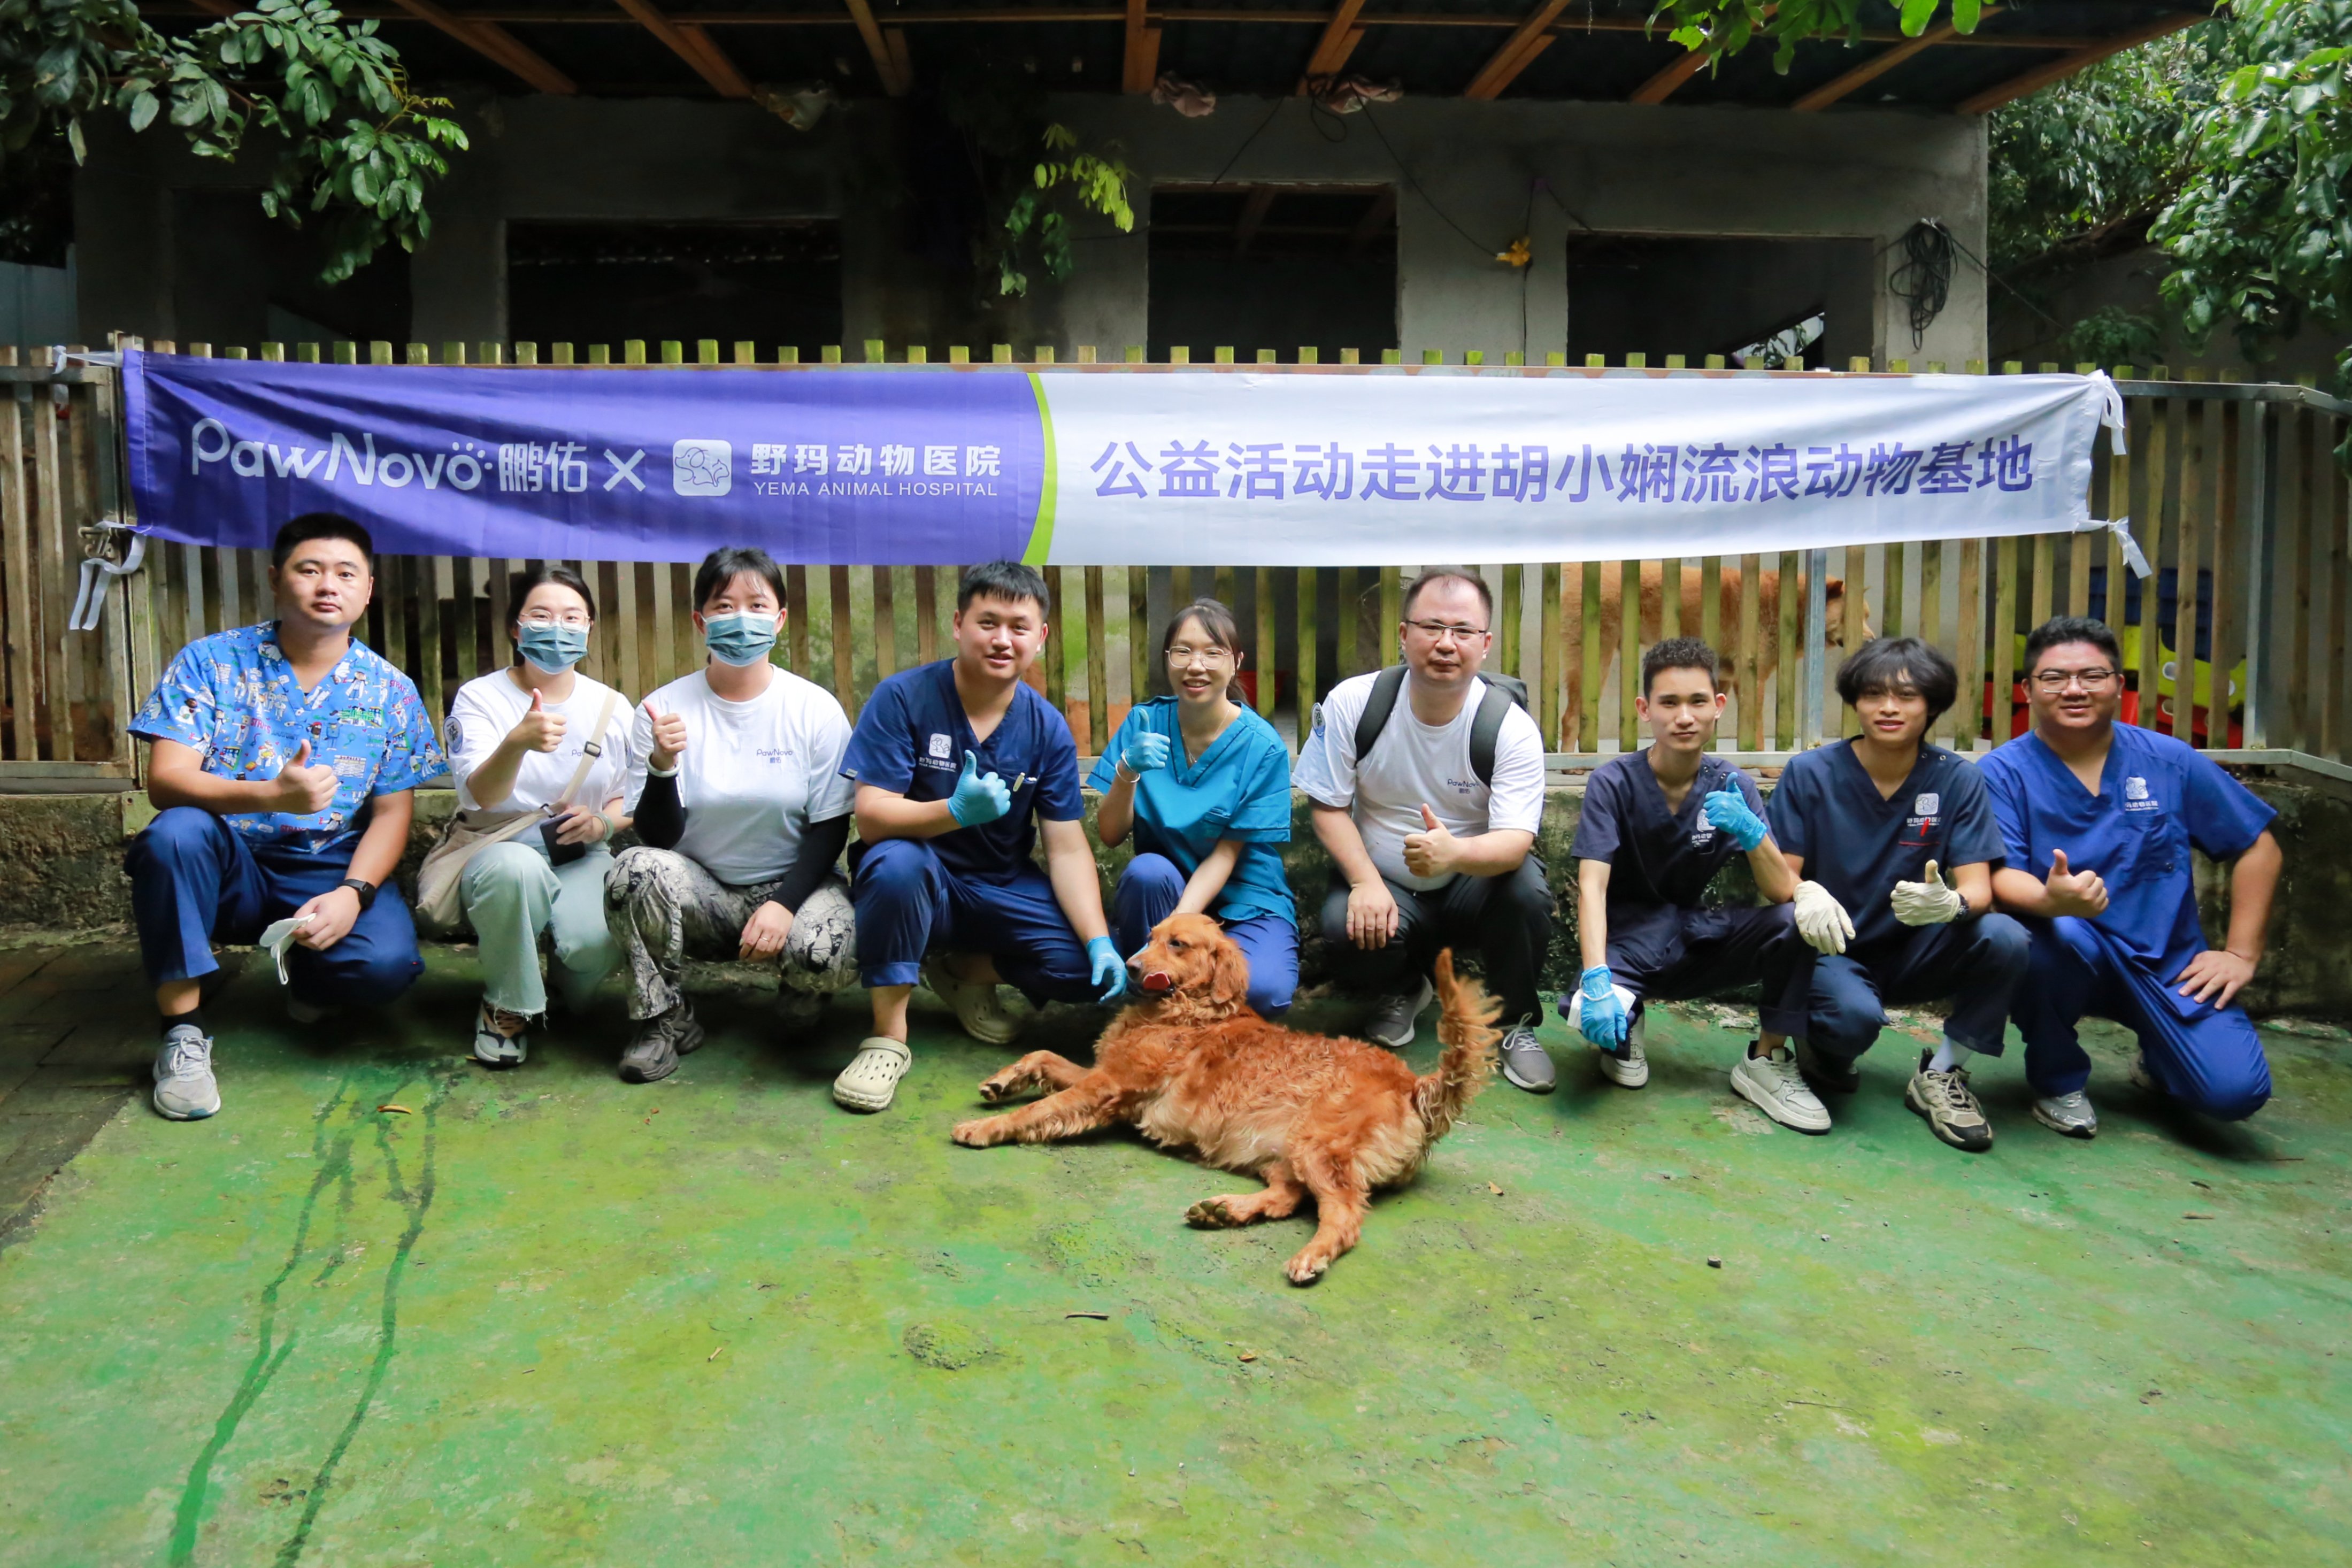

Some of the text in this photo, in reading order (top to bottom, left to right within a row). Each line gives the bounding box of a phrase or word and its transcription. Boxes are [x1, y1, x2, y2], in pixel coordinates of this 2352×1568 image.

[191, 417, 482, 490] PawNovo
[751, 443, 1001, 476] 野玛动物医院
[1090, 434, 2034, 503] 公益活动走进胡小娴流浪动物基地
[754, 482, 997, 496] YEMA ANIMAL HOSPITAL
